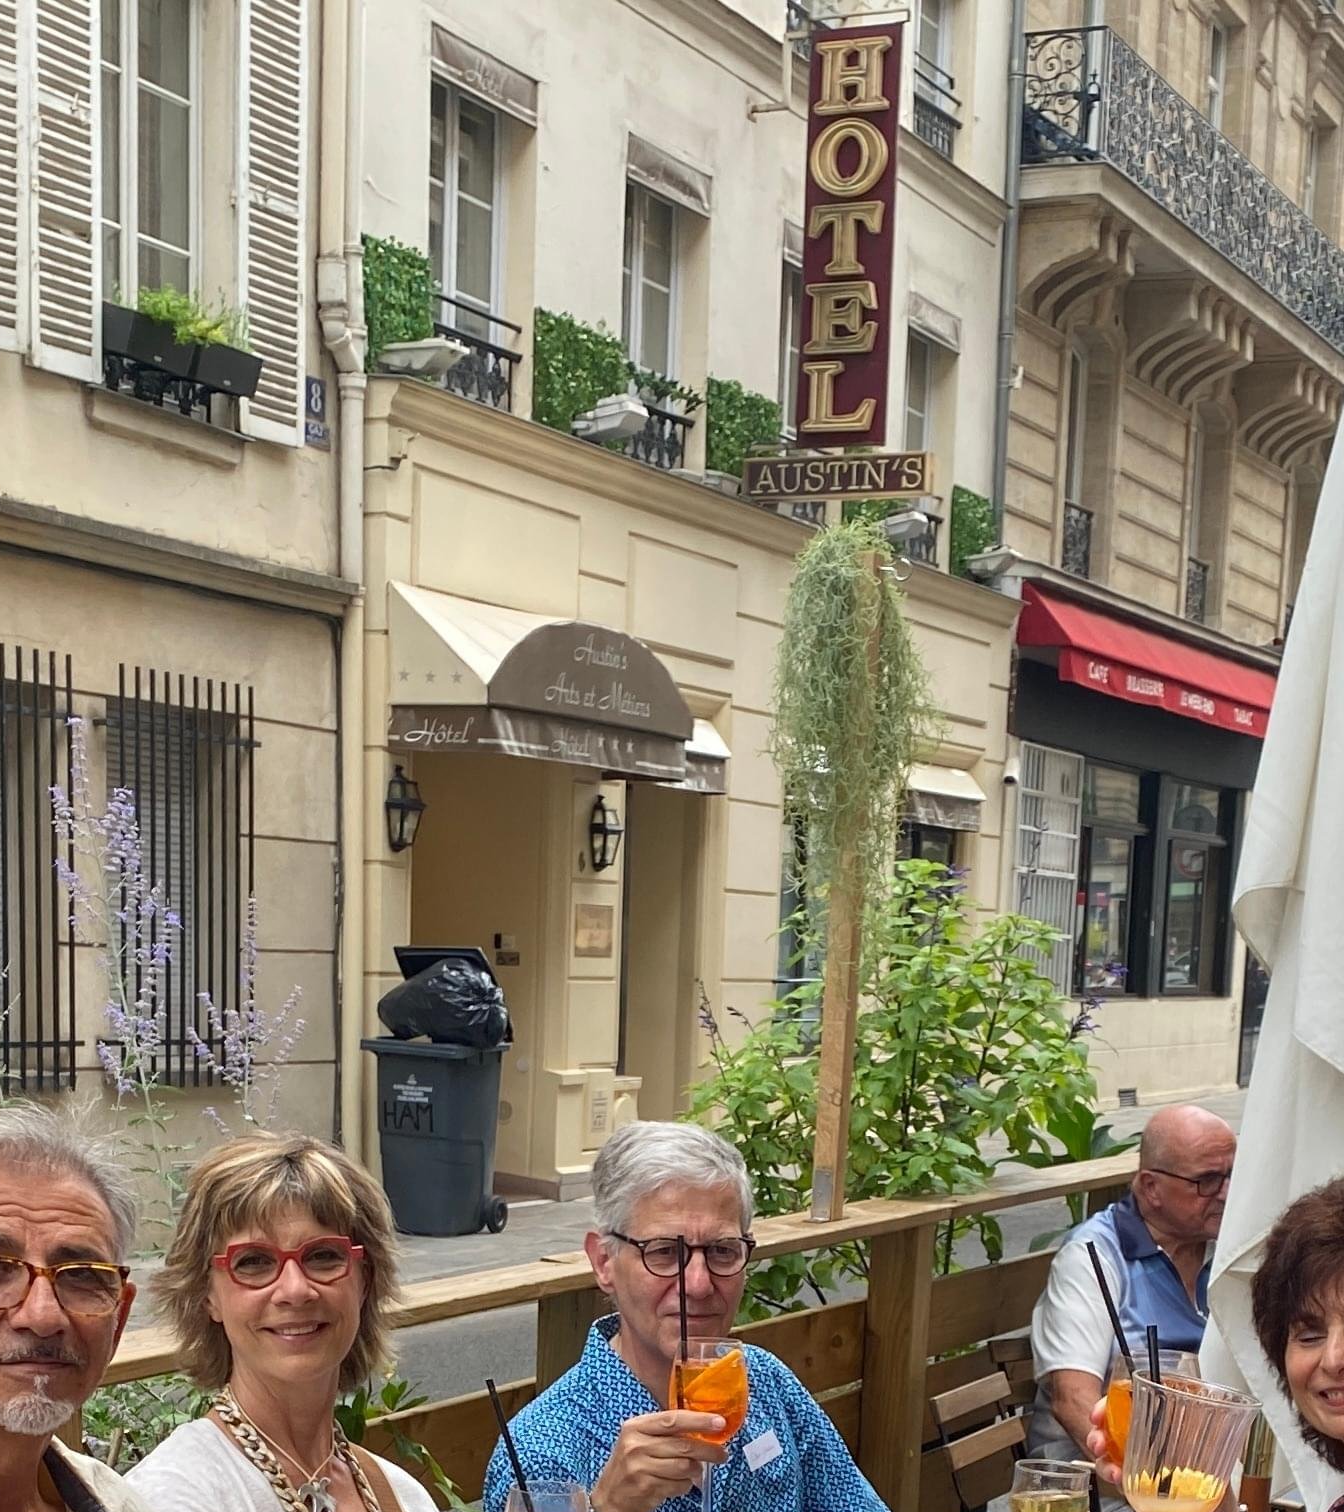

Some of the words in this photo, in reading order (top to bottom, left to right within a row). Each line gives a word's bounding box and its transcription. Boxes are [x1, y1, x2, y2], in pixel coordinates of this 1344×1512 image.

[800, 36, 892, 434] HOTEL
[310, 383, 322, 413] 8
[750, 457, 923, 496] AUSTIN'S
[544, 671, 580, 705] Arts
[583, 684, 596, 708] et
[404, 716, 474, 746] Hôtel
[383, 1101, 434, 1133] HAM
